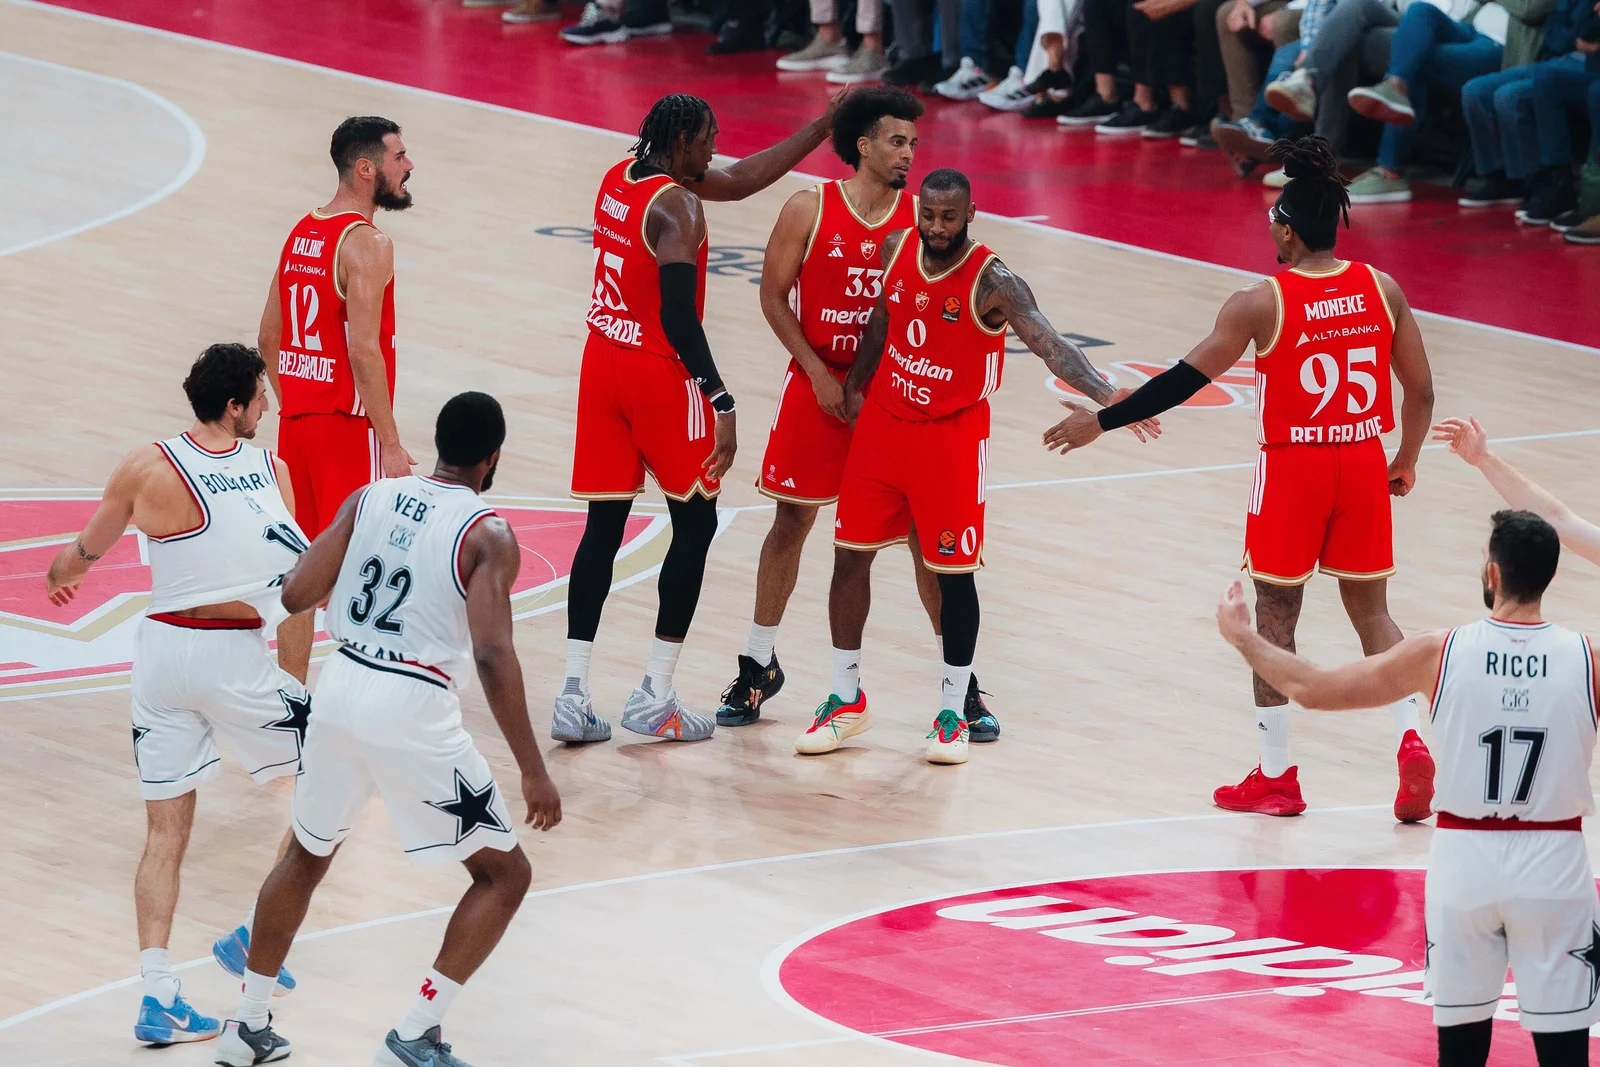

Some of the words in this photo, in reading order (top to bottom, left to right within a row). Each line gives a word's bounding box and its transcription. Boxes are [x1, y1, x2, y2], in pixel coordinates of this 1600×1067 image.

[845, 267, 884, 298] 33
[288, 283, 322, 351] 12
[1304, 294, 1366, 321] MONEKE
[907, 318, 926, 347] 0
[1312, 324, 1380, 341] ALTABANKA
[278, 350, 336, 382] BELGRADE
[888, 343, 953, 381] meridian
[891, 372, 931, 405] mts
[1300, 346, 1377, 420] 95
[960, 526, 977, 555] 0
[348, 554, 413, 636] 32
[1486, 651, 1547, 678] RICCI
[1478, 725, 1548, 805] 17
